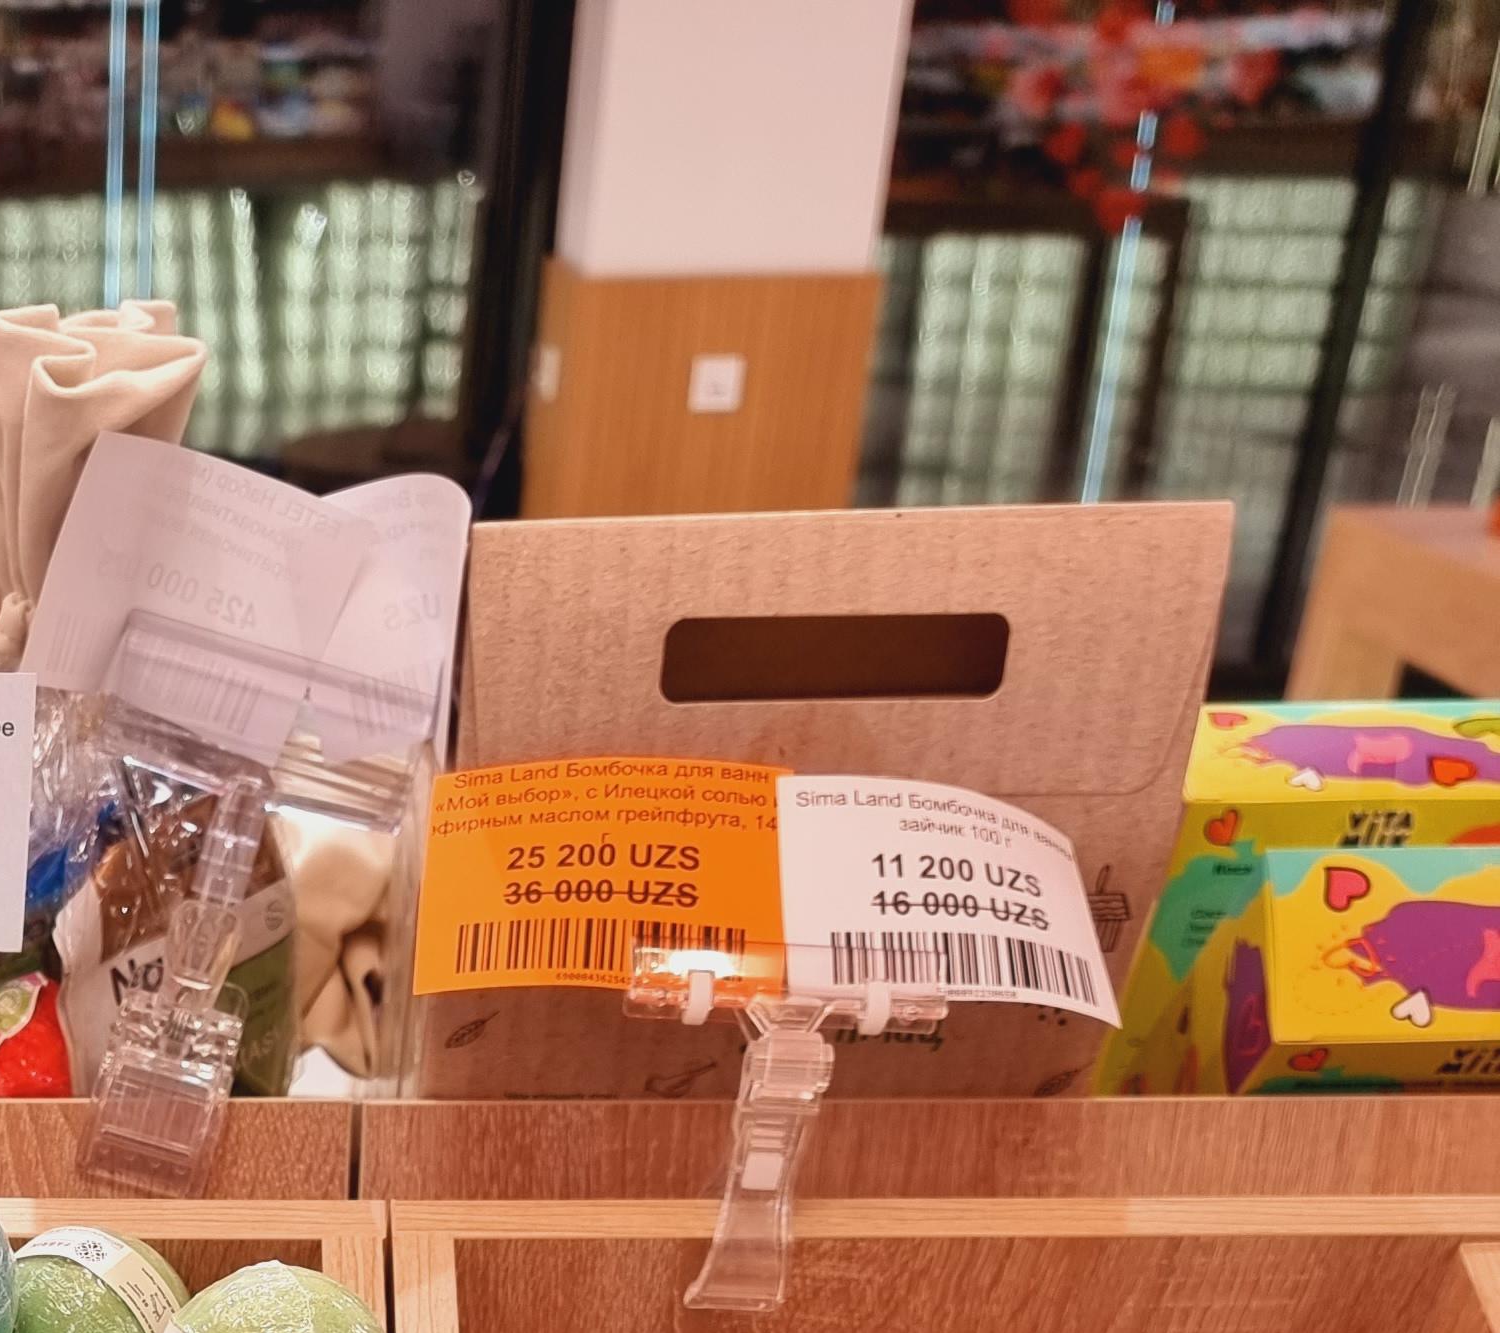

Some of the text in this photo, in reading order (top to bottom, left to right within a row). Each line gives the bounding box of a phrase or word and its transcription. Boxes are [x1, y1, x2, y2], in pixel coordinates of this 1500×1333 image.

[454, 760, 769, 789] Sima Land Бомбочка для ванн
[586, 788, 597, 799] с
[604, 782, 695, 804] Илецкой
[702, 789, 766, 806] солью
[795, 791, 997, 825] Sima Land Бомбочка
[529, 808, 610, 825] маслом
[617, 808, 747, 831] грейпфрута,
[507, 843, 700, 871] 25 200 UZS
[872, 853, 1042, 898] 11 200 UZS
[504, 879, 699, 908] 36 000 UZS
[870, 890, 1050, 931] 16 000 UZS
